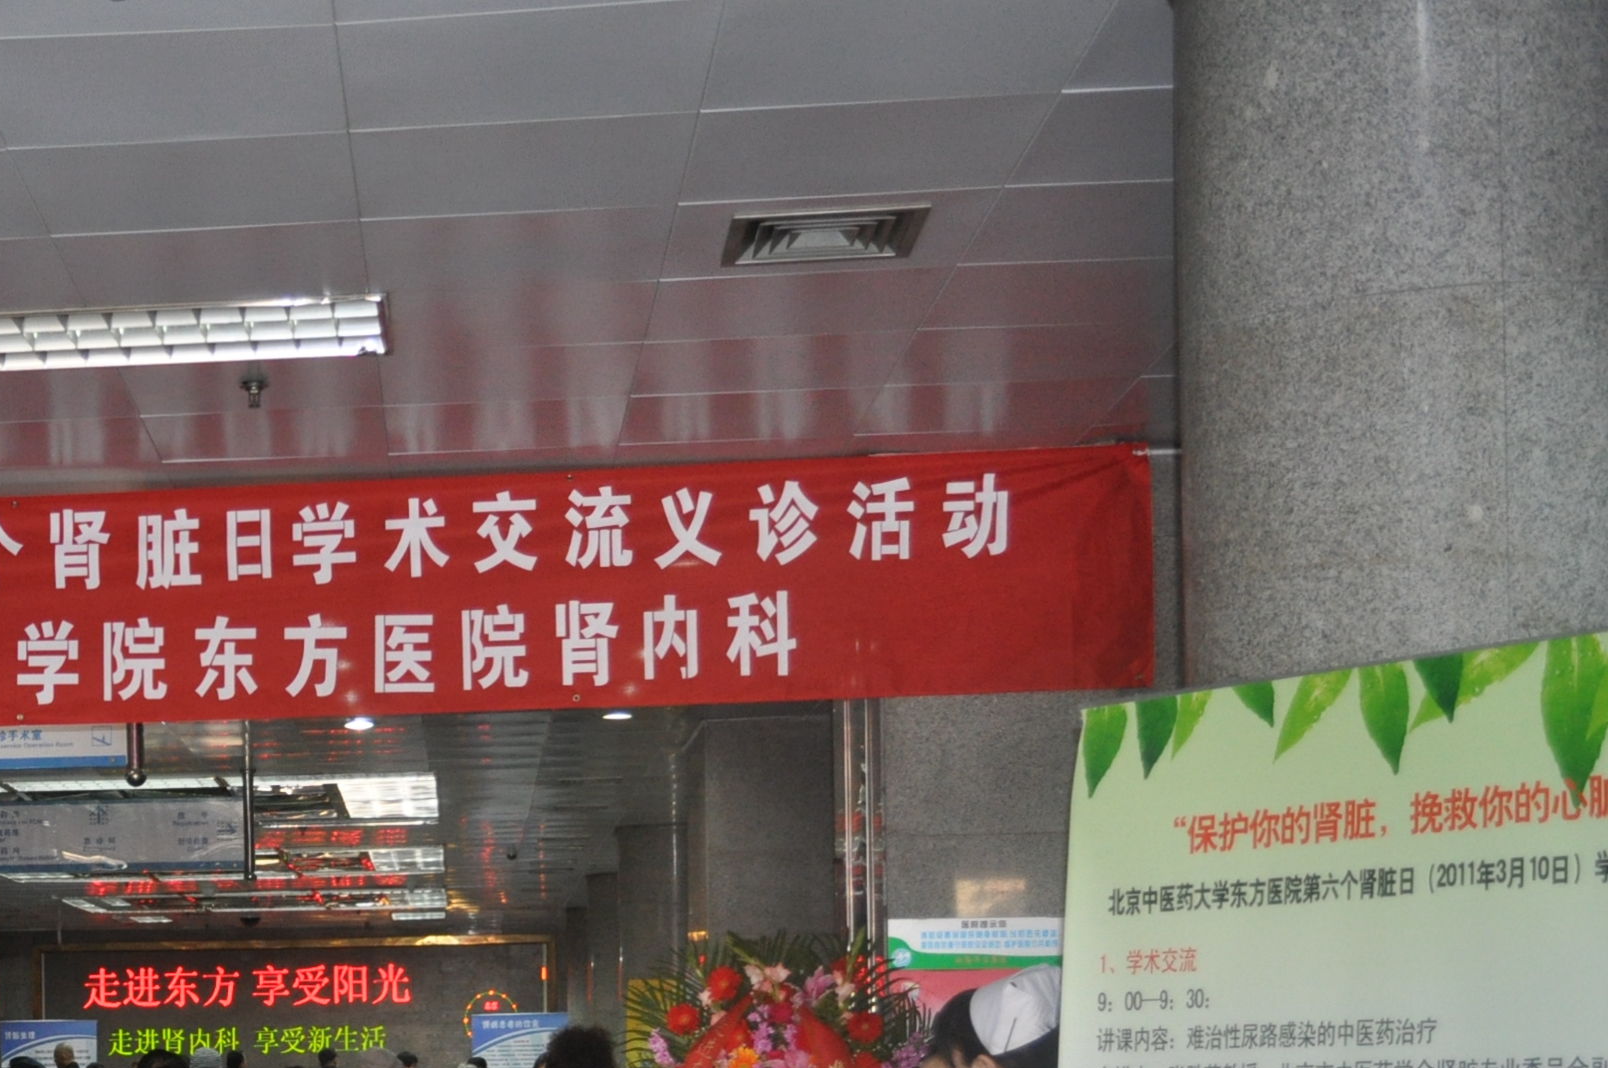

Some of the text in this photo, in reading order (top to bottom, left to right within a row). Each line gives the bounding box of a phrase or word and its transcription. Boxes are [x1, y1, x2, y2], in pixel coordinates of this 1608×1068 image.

[84, 962, 412, 1010] 走进东方 享受阳光
[108, 1024, 388, 1057] 走进肾内科 享受新生活
